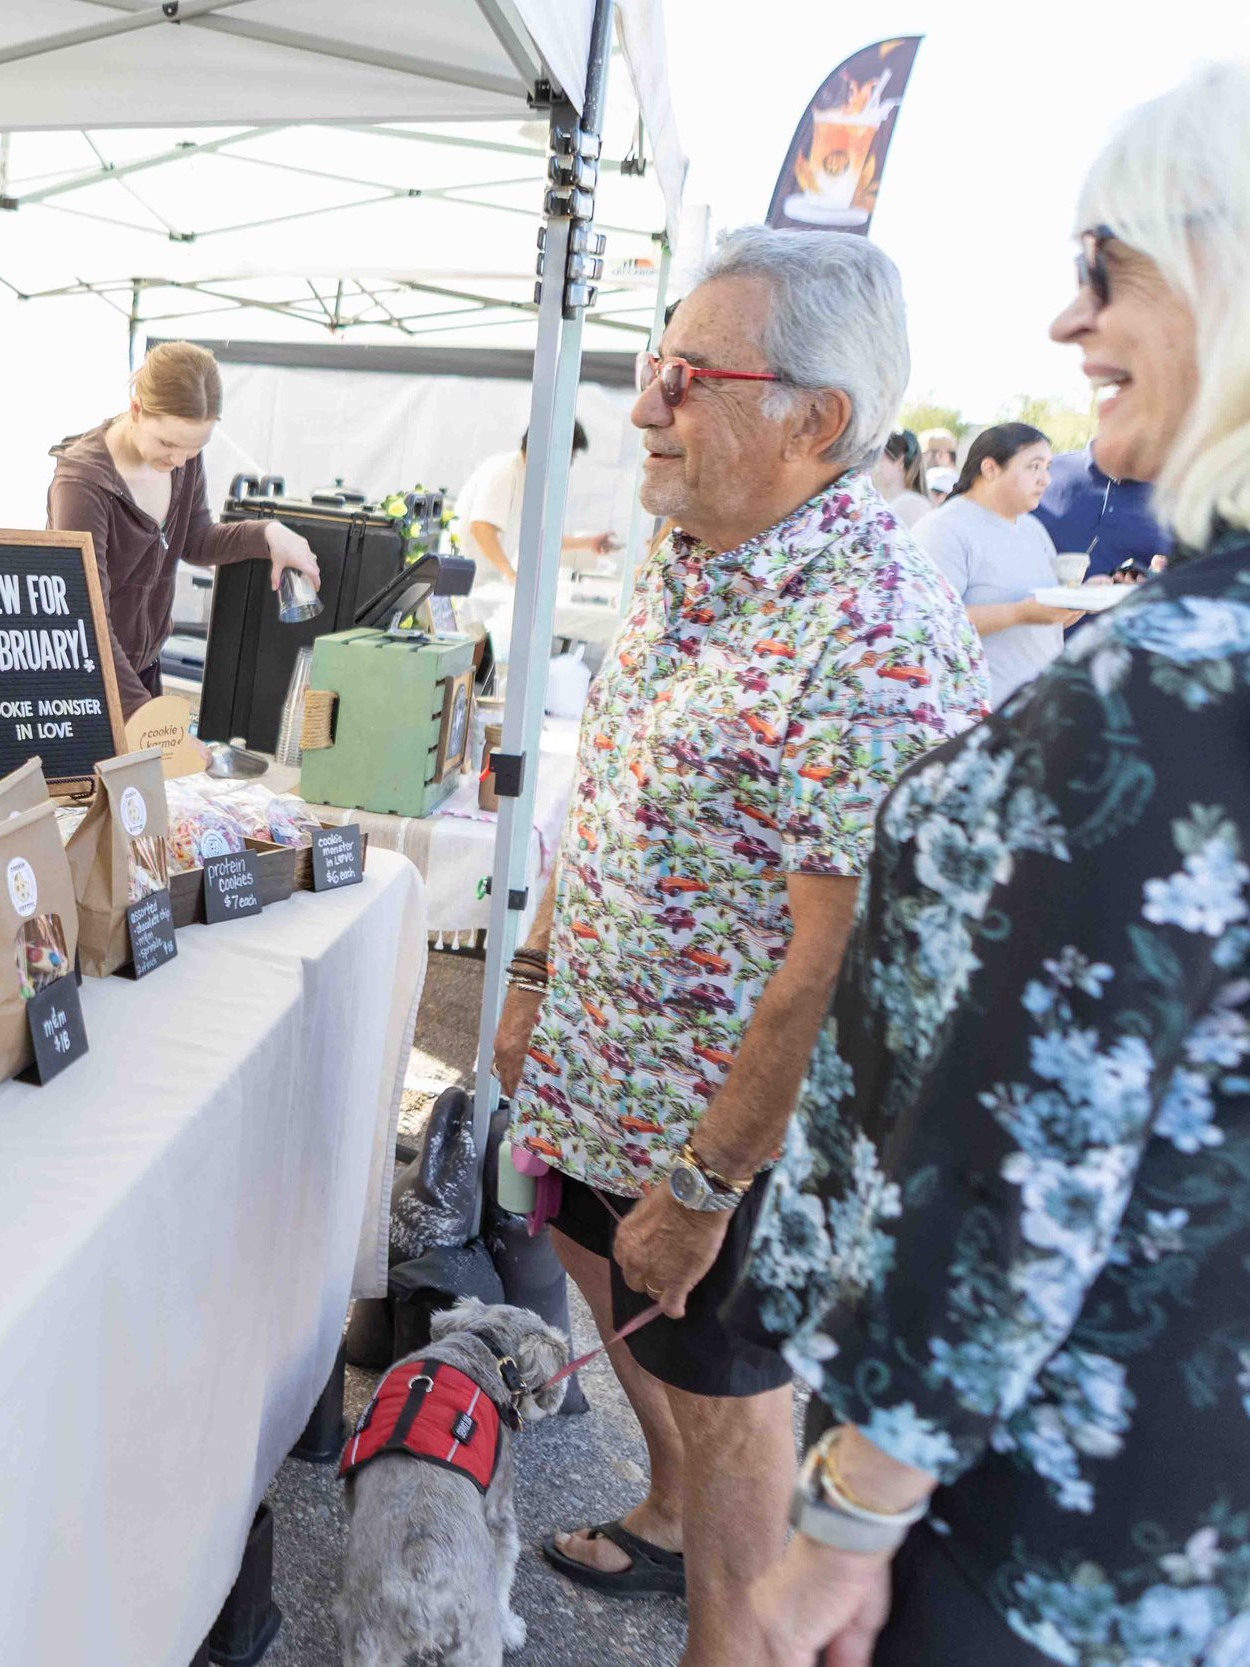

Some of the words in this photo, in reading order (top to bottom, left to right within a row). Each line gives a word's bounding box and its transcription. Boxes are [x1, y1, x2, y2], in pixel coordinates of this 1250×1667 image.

[26, 574, 70, 617] FOR
[38, 698, 102, 718] MONSTER
[37, 721, 74, 740] LOVE
[147, 724, 178, 739] cookie
[318, 834, 343, 848] cookie
[322, 840, 354, 856] monster
[325, 857, 334, 868] in
[207, 857, 246, 888] protein
[326, 870, 340, 884] $6
[339, 866, 356, 881] each
[218, 872, 254, 893] cookies
[238, 893, 258, 908] each
[130, 899, 158, 924] assorted
[54, 1030, 71, 1054] $18
